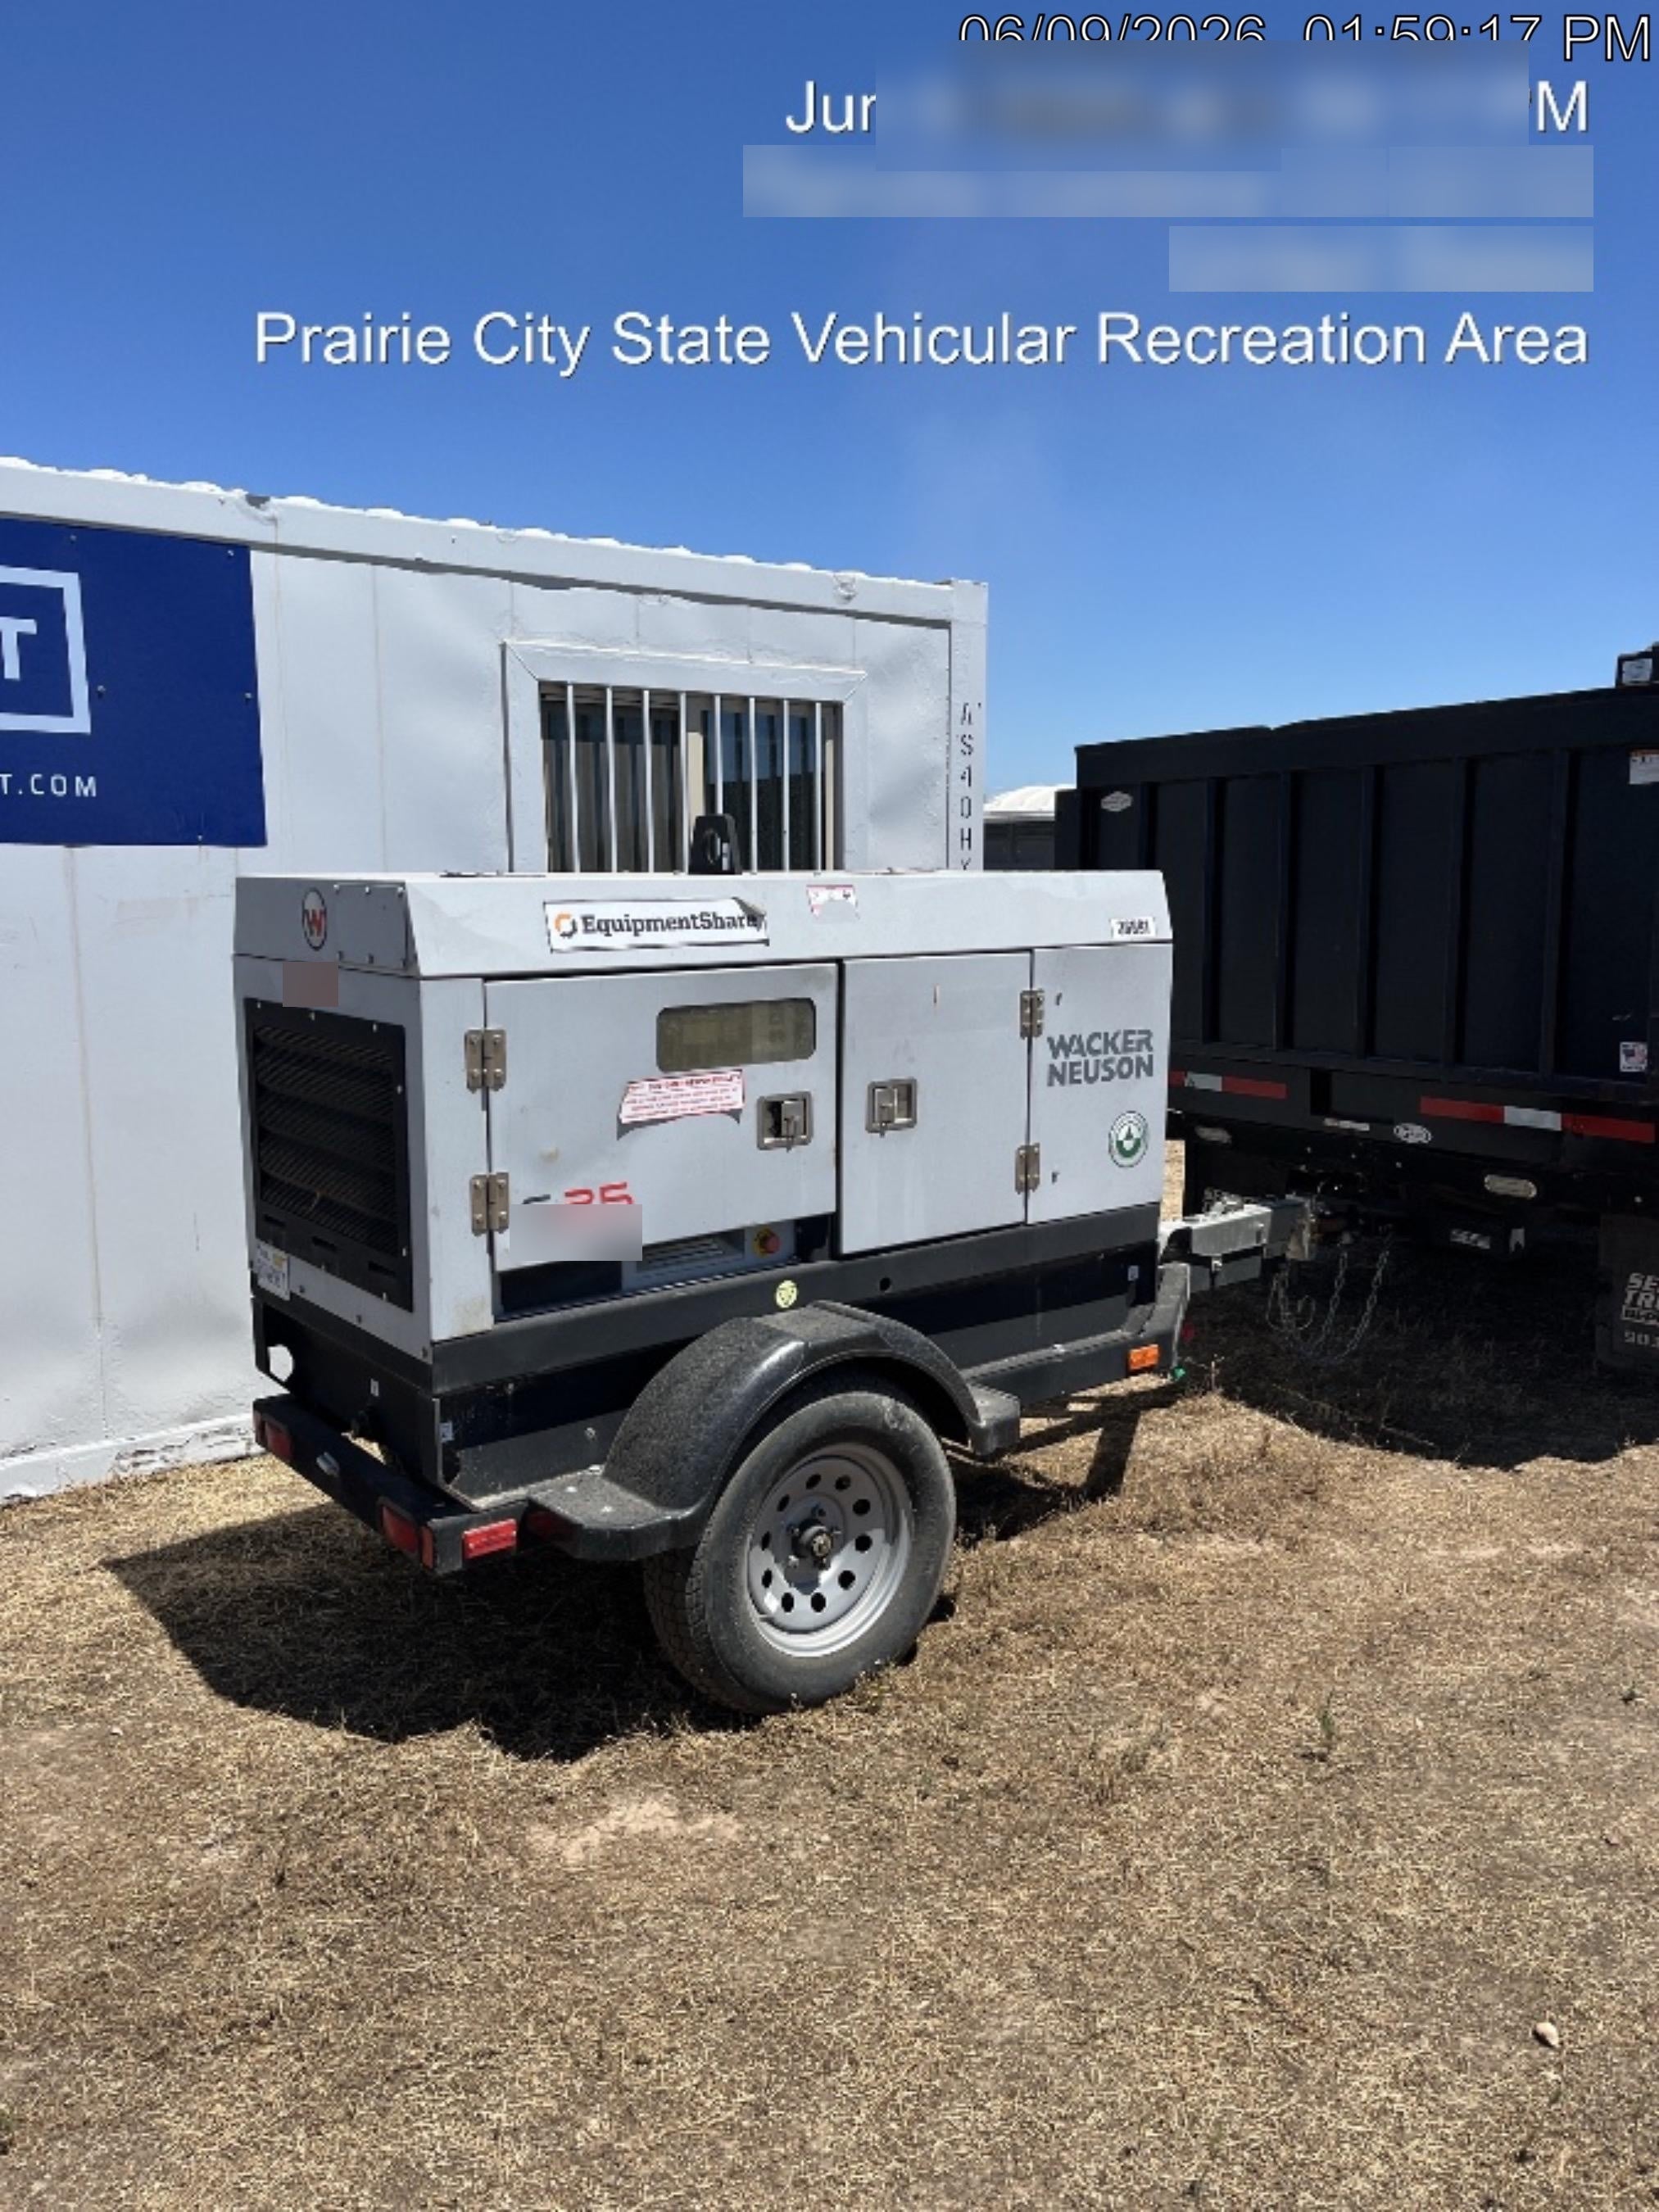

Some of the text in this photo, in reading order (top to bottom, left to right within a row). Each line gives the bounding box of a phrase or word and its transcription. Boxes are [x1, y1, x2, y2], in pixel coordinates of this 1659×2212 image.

[1046, 1029, 1154, 1059] WACKER
[1046, 1054, 1154, 1087] NEUSON
[1628, 1271, 1659, 1291] SE
[1625, 1289, 1659, 1310] TR
